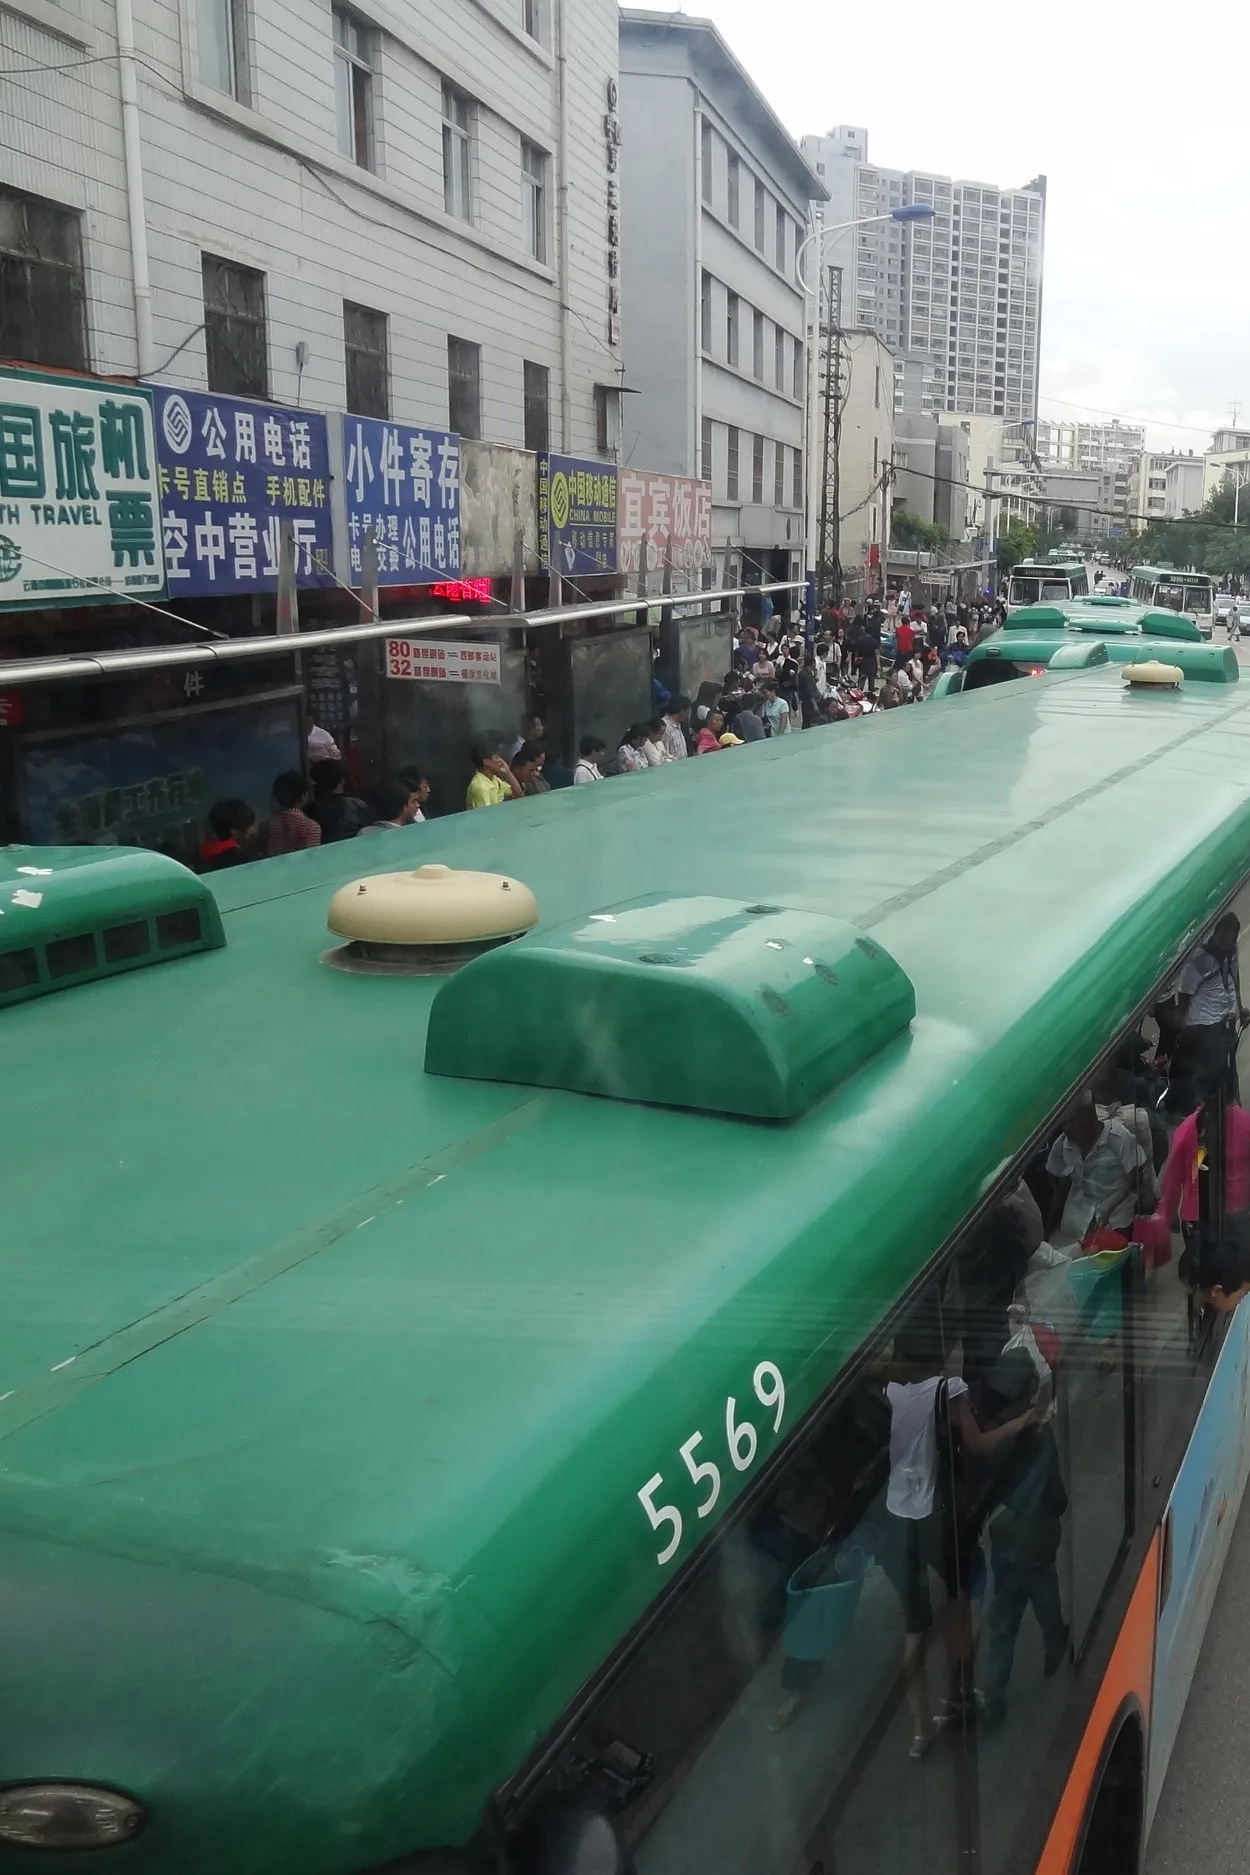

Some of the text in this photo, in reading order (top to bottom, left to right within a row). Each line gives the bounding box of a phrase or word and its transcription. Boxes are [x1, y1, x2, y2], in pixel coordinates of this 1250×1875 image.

[200, 407, 313, 470] 公用电话
[347, 423, 460, 509] 小件寄存
[266, 476, 326, 509] 手机配件
[568, 470, 617, 509] 中国移动通信
[620, 470, 712, 539] 宜宾饭店
[30, 504, 103, 526] TRAVEL
[348, 511, 399, 541] 卡号办理
[569, 509, 616, 524] CHINA MOBILE
[162, 509, 318, 582] 空中营业厅
[350, 543, 400, 572] 电交费
[402, 515, 460, 571] 公用电话
[388, 640, 410, 658] 80
[389, 659, 412, 676] 32
[637, 1360, 785, 1566] 5569
